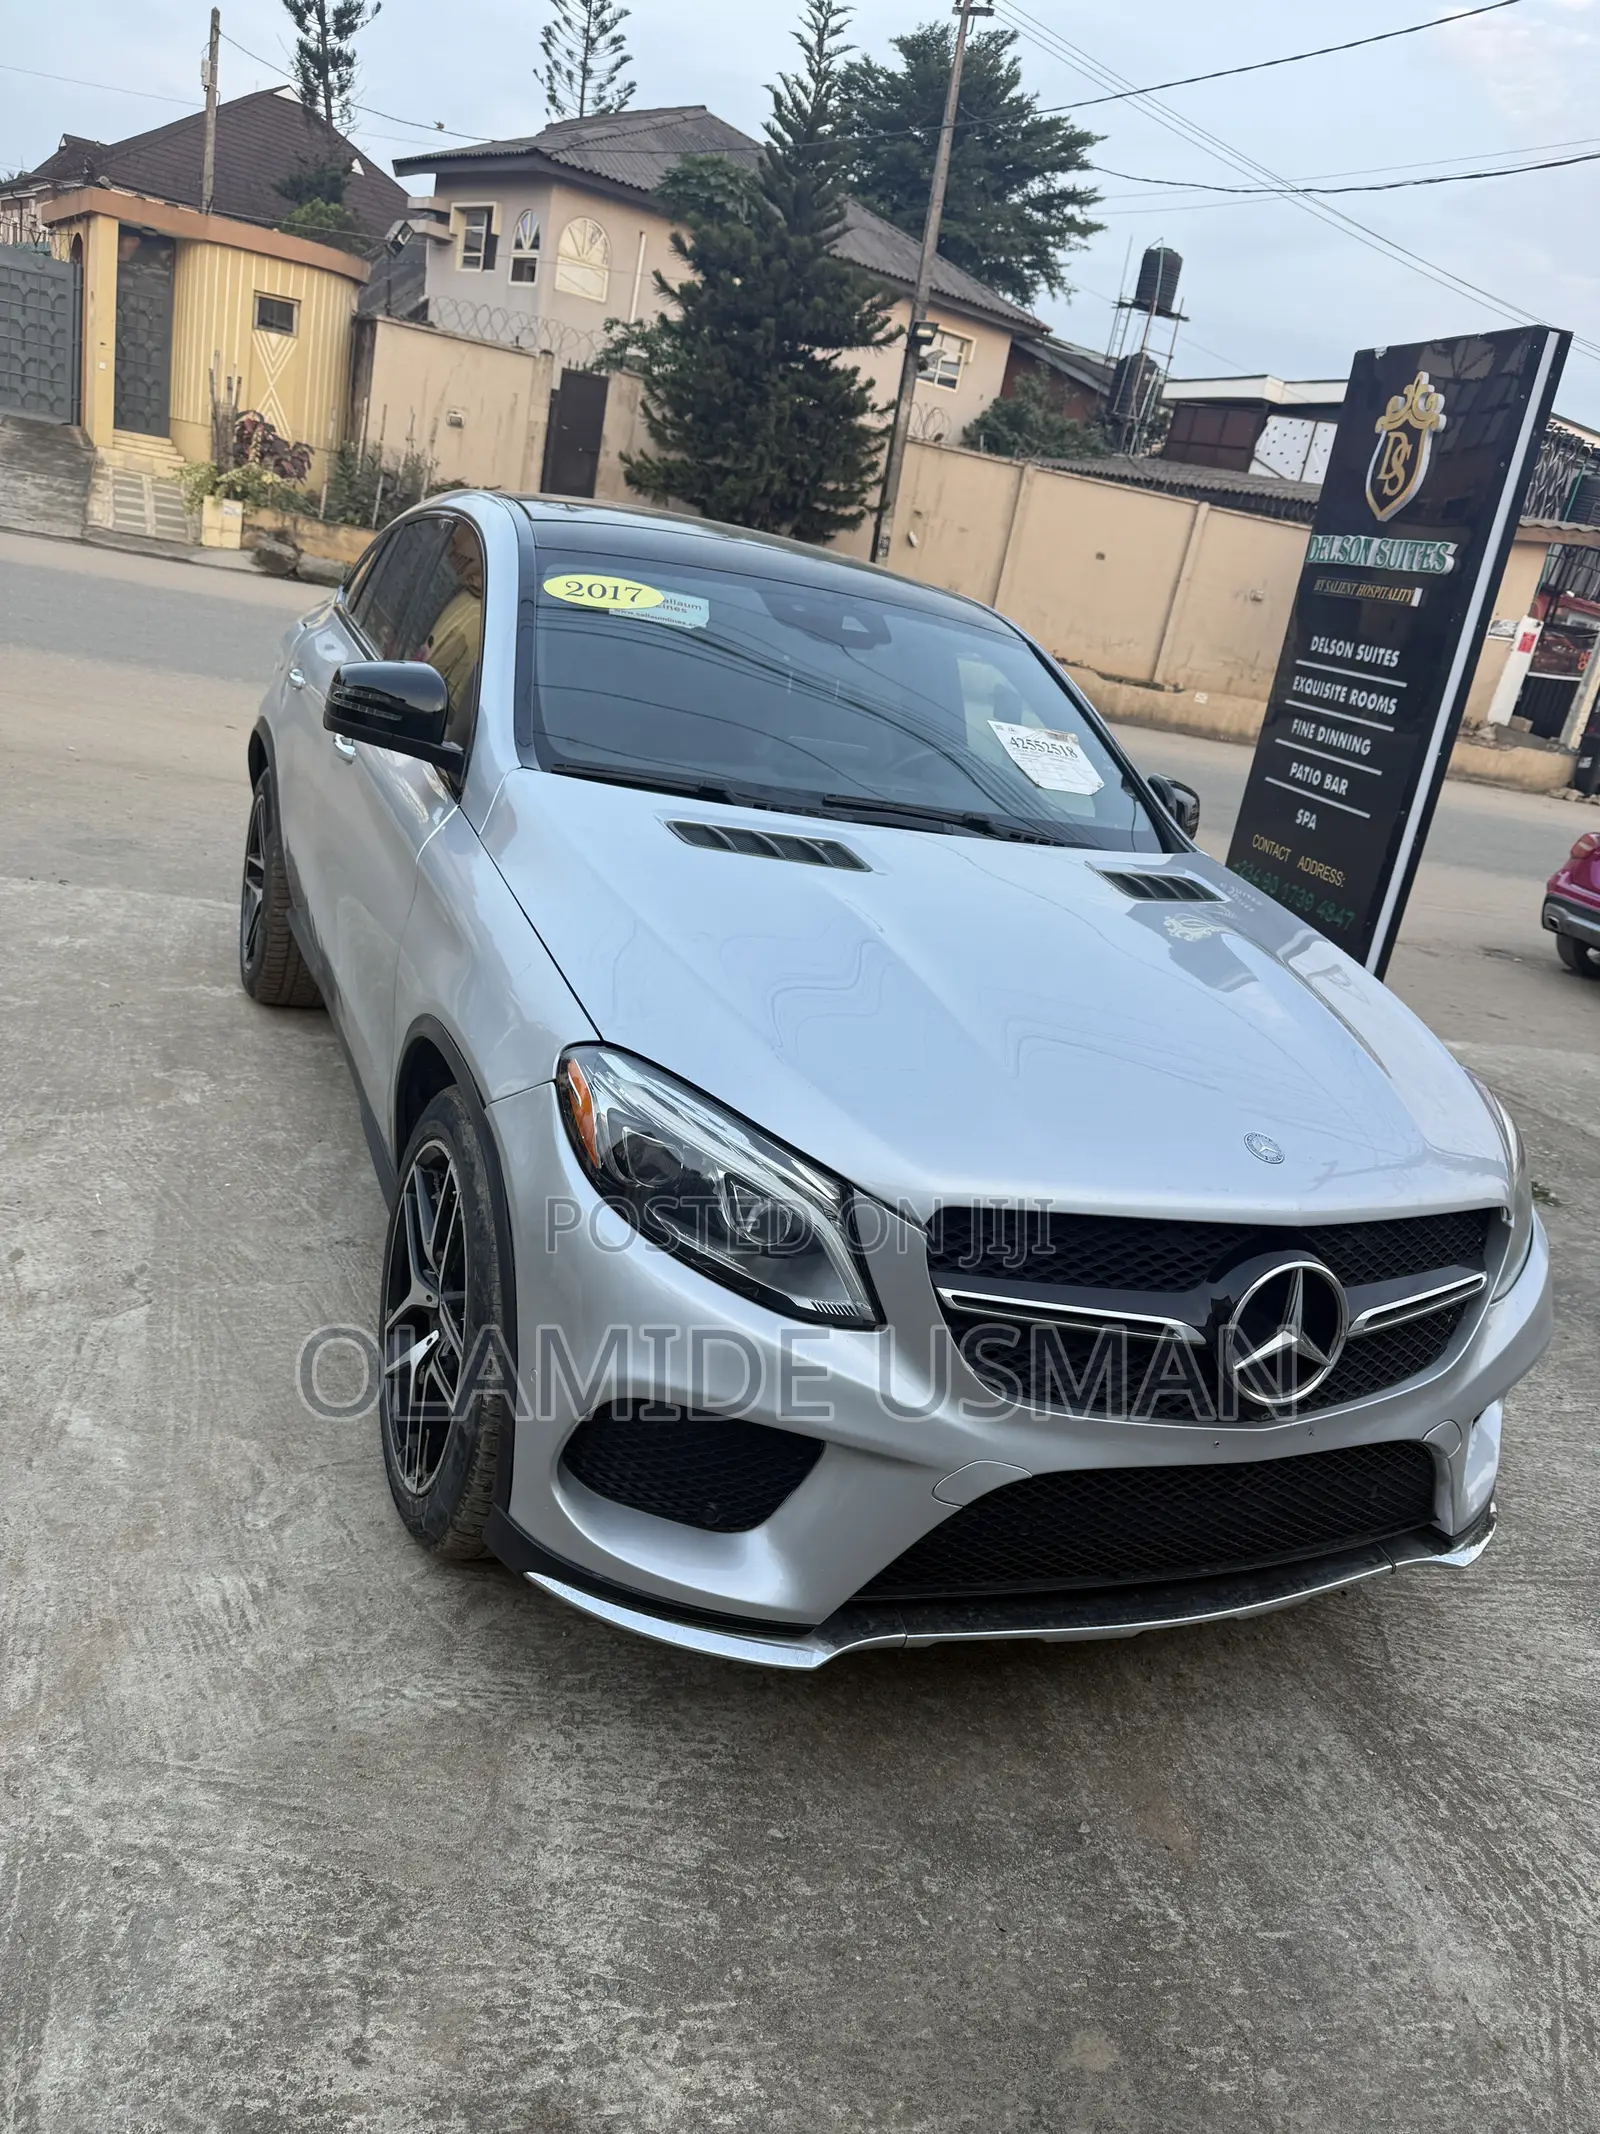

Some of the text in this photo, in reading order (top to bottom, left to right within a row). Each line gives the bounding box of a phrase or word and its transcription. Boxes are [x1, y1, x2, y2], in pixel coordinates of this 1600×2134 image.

[1306, 535, 1459, 575] DELSON SUITES
[564, 580, 643, 603] 2017
[662, 598, 702, 612] allaum
[1314, 579, 1415, 604] BY SALIENT HOSPITALITY
[1310, 635, 1400, 668] DELSON SUITES
[1292, 675, 1398, 715] EXQUISITE ROOMS
[1009, 736, 1078, 759] 42552518
[1291, 718, 1372, 756] FINE DINNING
[1289, 761, 1349, 797] PATIO BAR
[1295, 808, 1317, 830] SPA
[1252, 833, 1346, 888] CONTACT ADDRESS:
